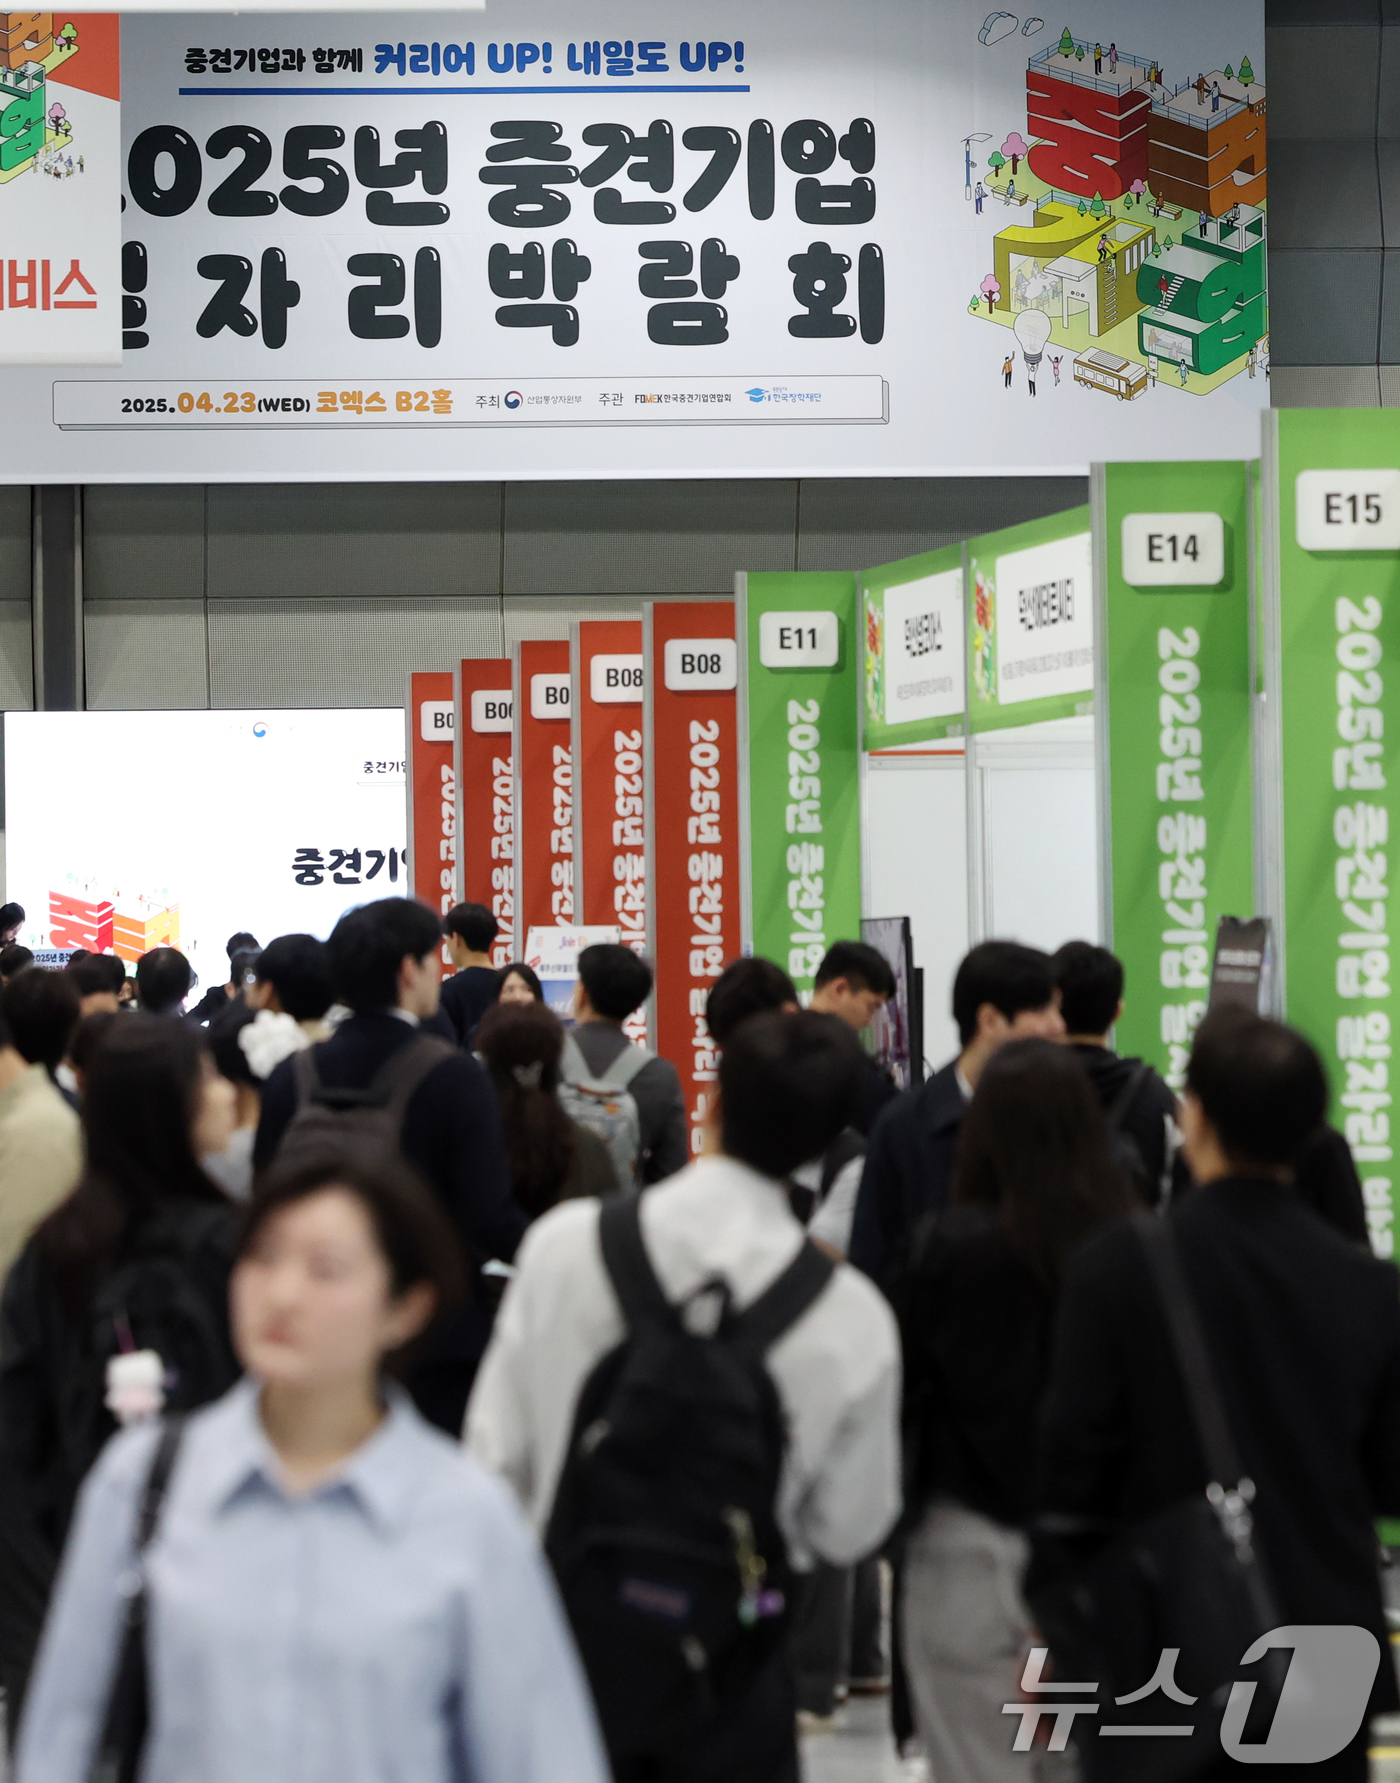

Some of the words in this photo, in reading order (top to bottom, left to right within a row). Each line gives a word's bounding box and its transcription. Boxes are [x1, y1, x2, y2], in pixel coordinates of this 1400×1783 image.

[184, 47, 306, 74] 중견기업과
[312, 47, 363, 73] 함께
[374, 41, 475, 76] 커리어
[487, 41, 552, 74] UP!
[567, 40, 669, 76] 내일도
[679, 40, 744, 73] UP!
[121, 120, 450, 226] 025년
[478, 117, 876, 228] 중견기업
[0, 259, 97, 311] 비스
[316, 390, 387, 415] 코엑스
[395, 388, 454, 414] B2홀
[475, 395, 500, 409] 주최
[527, 395, 582, 405] 산업통상자원부
[599, 393, 624, 407] 주관
[664, 394, 732, 403] 한국중견기업연합회
[772, 393, 822, 403] 한국장학재단
[1147, 533, 1200, 563] E14
[1324, 493, 1383, 524] E15
[681, 654, 722, 675] B08
[779, 627, 818, 651] E11
[606, 669, 643, 689] B08
[1157, 626, 1204, 801] 2025년
[1333, 595, 1387, 792] 2025년
[612, 729, 644, 846] 2025년
[687, 719, 723, 844] 2025년
[786, 698, 823, 835] 2025년
[292, 847, 407, 886] 중견기
[613, 852, 646, 958] 중견기
[1157, 811, 1209, 989] 중견기업
[1333, 801, 1391, 998] 중견기업
[688, 850, 724, 977] 중견기업
[786, 840, 826, 978] 중견기업
[1336, 1011, 1393, 1162] 일자리
